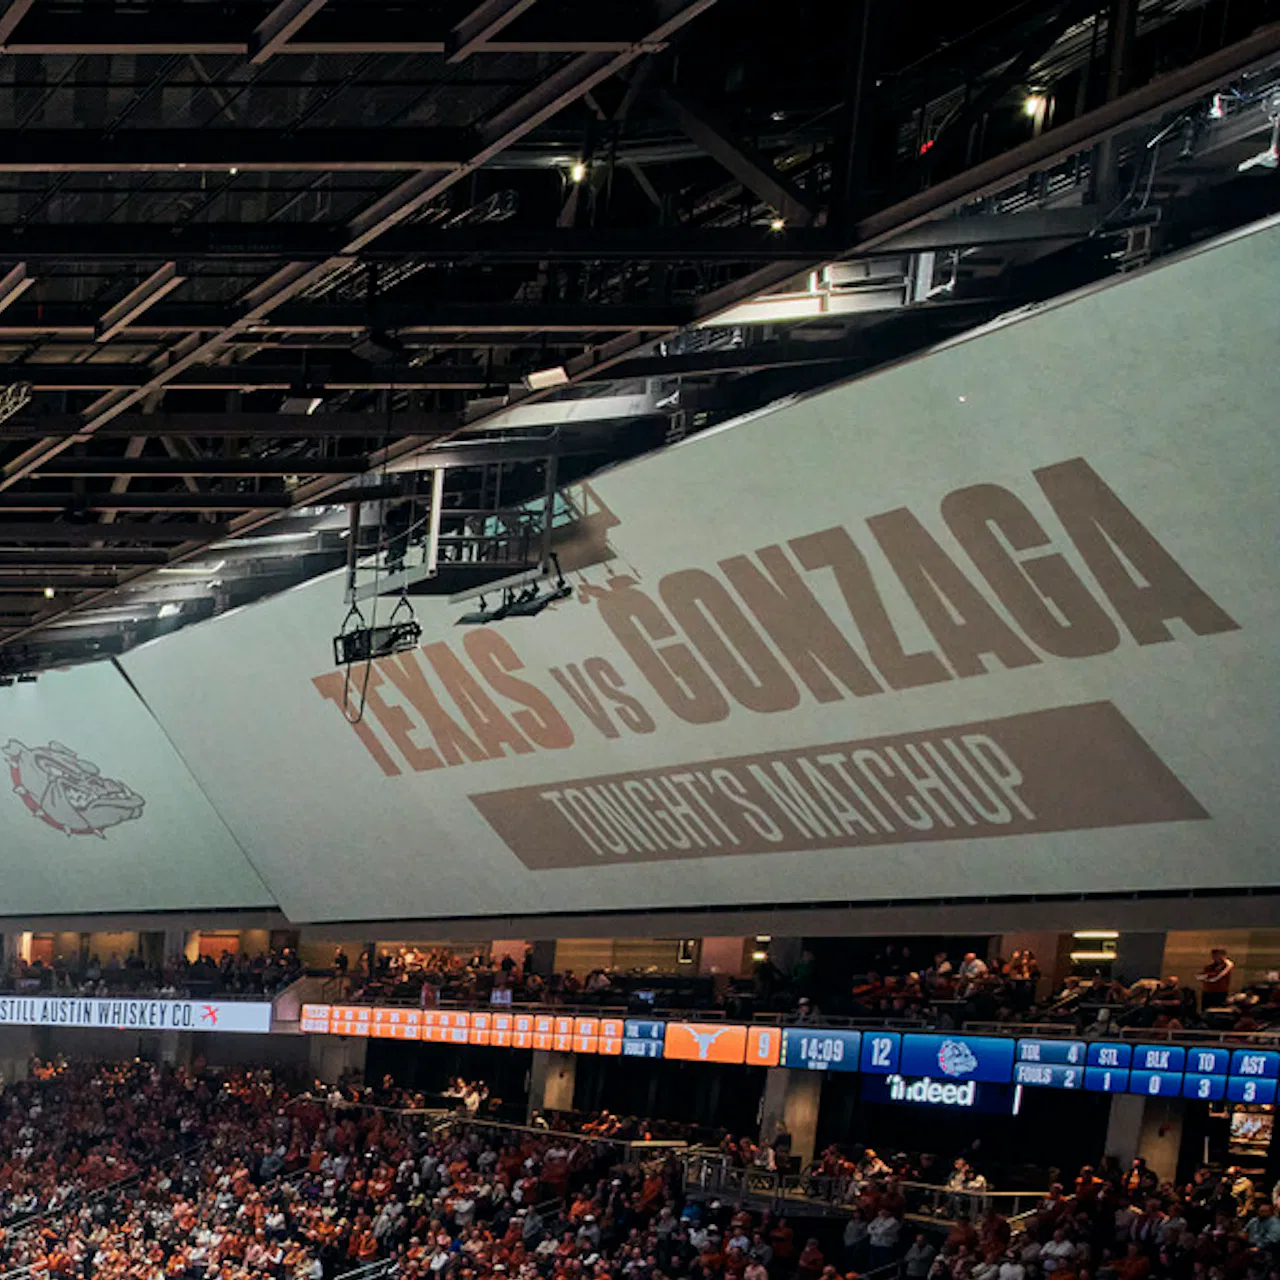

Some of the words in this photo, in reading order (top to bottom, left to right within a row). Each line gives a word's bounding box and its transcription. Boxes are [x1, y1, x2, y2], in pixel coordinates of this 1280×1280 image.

[597, 457, 1242, 726] GONZAGA
[311, 628, 574, 777] TEXAS
[548, 656, 656, 740] VS
[542, 763, 783, 856] TONIGHT'S
[746, 733, 1038, 842] MATCHUP
[0, 1000, 36, 1022] STILL
[40, 1001, 93, 1024] AUSTIN
[98, 1003, 168, 1026] WHISKEY
[171, 1004, 196, 1028] CO.
[758, 1036, 770, 1058] 9
[800, 1037, 845, 1062] 14:09
[871, 1037, 893, 1067] 12
[1067, 1045, 1078, 1064] 4
[1097, 1048, 1119, 1067] STL
[1145, 1051, 1170, 1069] BLK
[1197, 1053, 1215, 1072] TO
[1240, 1055, 1267, 1075] AST
[1017, 1066, 1052, 1084] FOULS
[1063, 1069, 1074, 1088] 2
[1102, 1072, 1111, 1091] 1
[1149, 1075, 1162, 1095] 0
[887, 1074, 975, 1107] indeed
[1197, 1079, 1210, 1099] 3
[1243, 1081, 1257, 1102] 3
